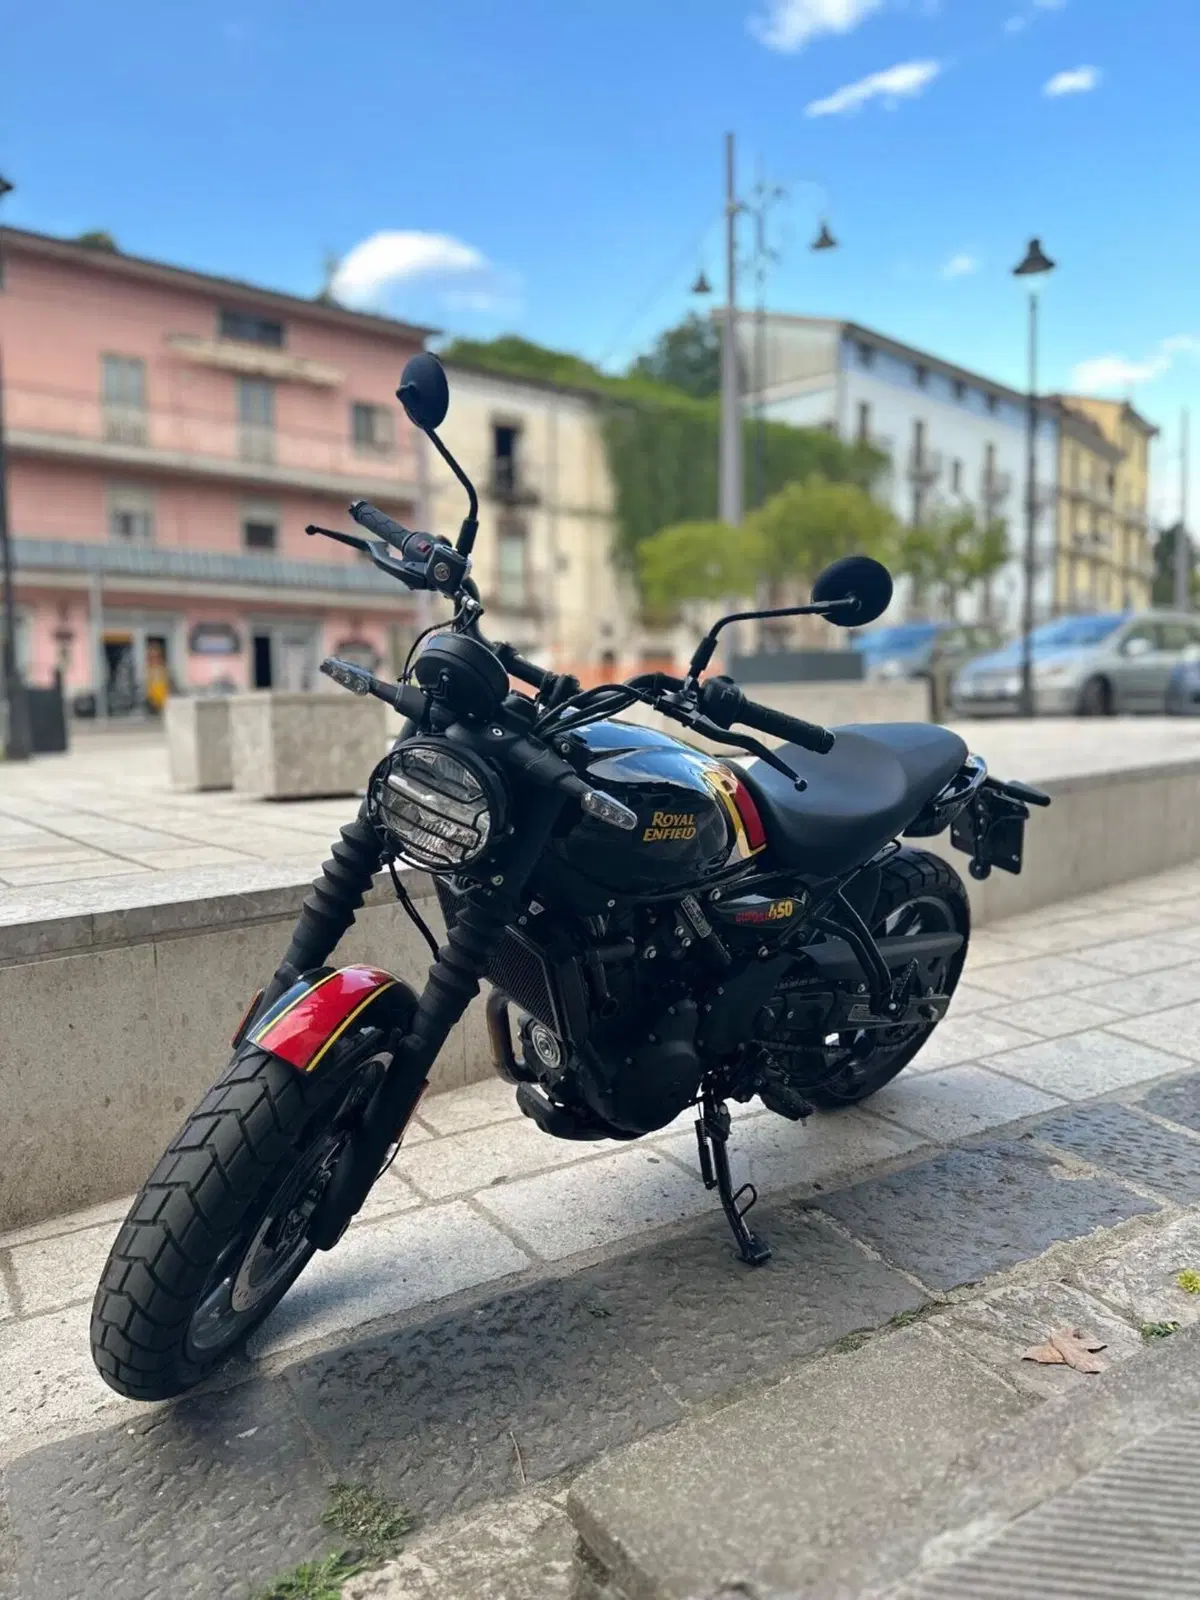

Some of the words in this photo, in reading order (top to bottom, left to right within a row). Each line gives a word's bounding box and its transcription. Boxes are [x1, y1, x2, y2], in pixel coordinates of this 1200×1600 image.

[652, 811, 695, 827] ROYAL
[643, 827, 696, 841] ENFIELD
[768, 900, 793, 920] 450
